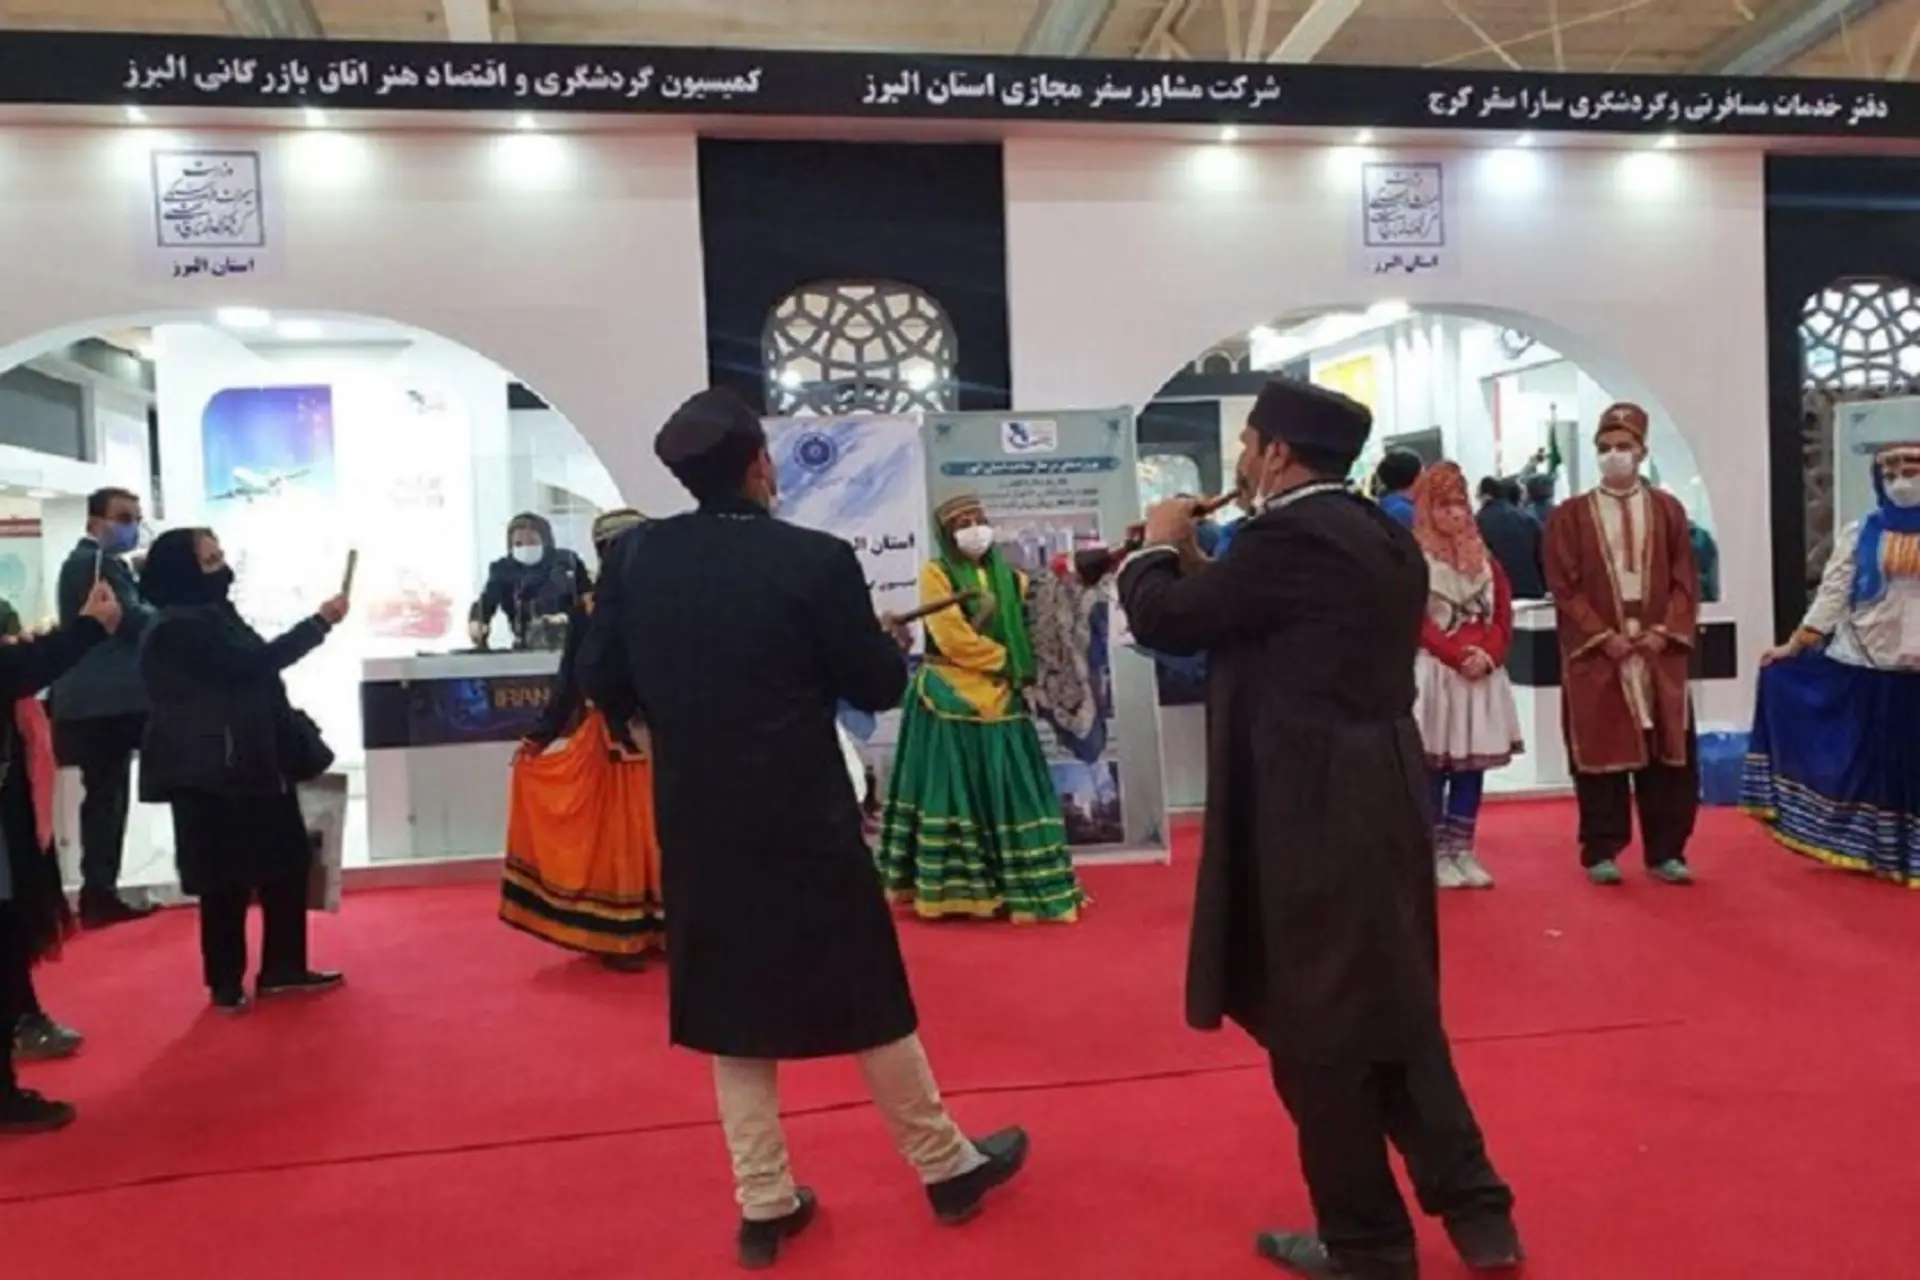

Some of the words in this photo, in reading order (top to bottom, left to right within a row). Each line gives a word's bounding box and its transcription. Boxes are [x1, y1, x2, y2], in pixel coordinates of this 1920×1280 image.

[122, 53, 187, 89] البرز
[317, 58, 368, 94] اتاق
[375, 63, 420, 95] هنر
[425, 58, 507, 87] اقتصاد
[513, 73, 529, 96] و
[660, 66, 763, 99] کمیسیون
[862, 69, 920, 104] البرز
[926, 71, 995, 105] استان
[1001, 73, 1083, 107] مجازی
[1089, 73, 1132, 108] سفر
[1135, 74, 1203, 107] مشاور
[1207, 74, 1281, 108] شرکت
[1428, 84, 1474, 117] کرج
[1477, 86, 1516, 117] سفر
[1520, 87, 1565, 119] سارا
[1684, 88, 1769, 121] مسافرتی
[1773, 93, 1843, 117] خدمات
[1847, 93, 1889, 126] دفتر
[172, 256, 209, 278] البرز
[210, 256, 254, 277] استان
[869, 529, 916, 558] استان
